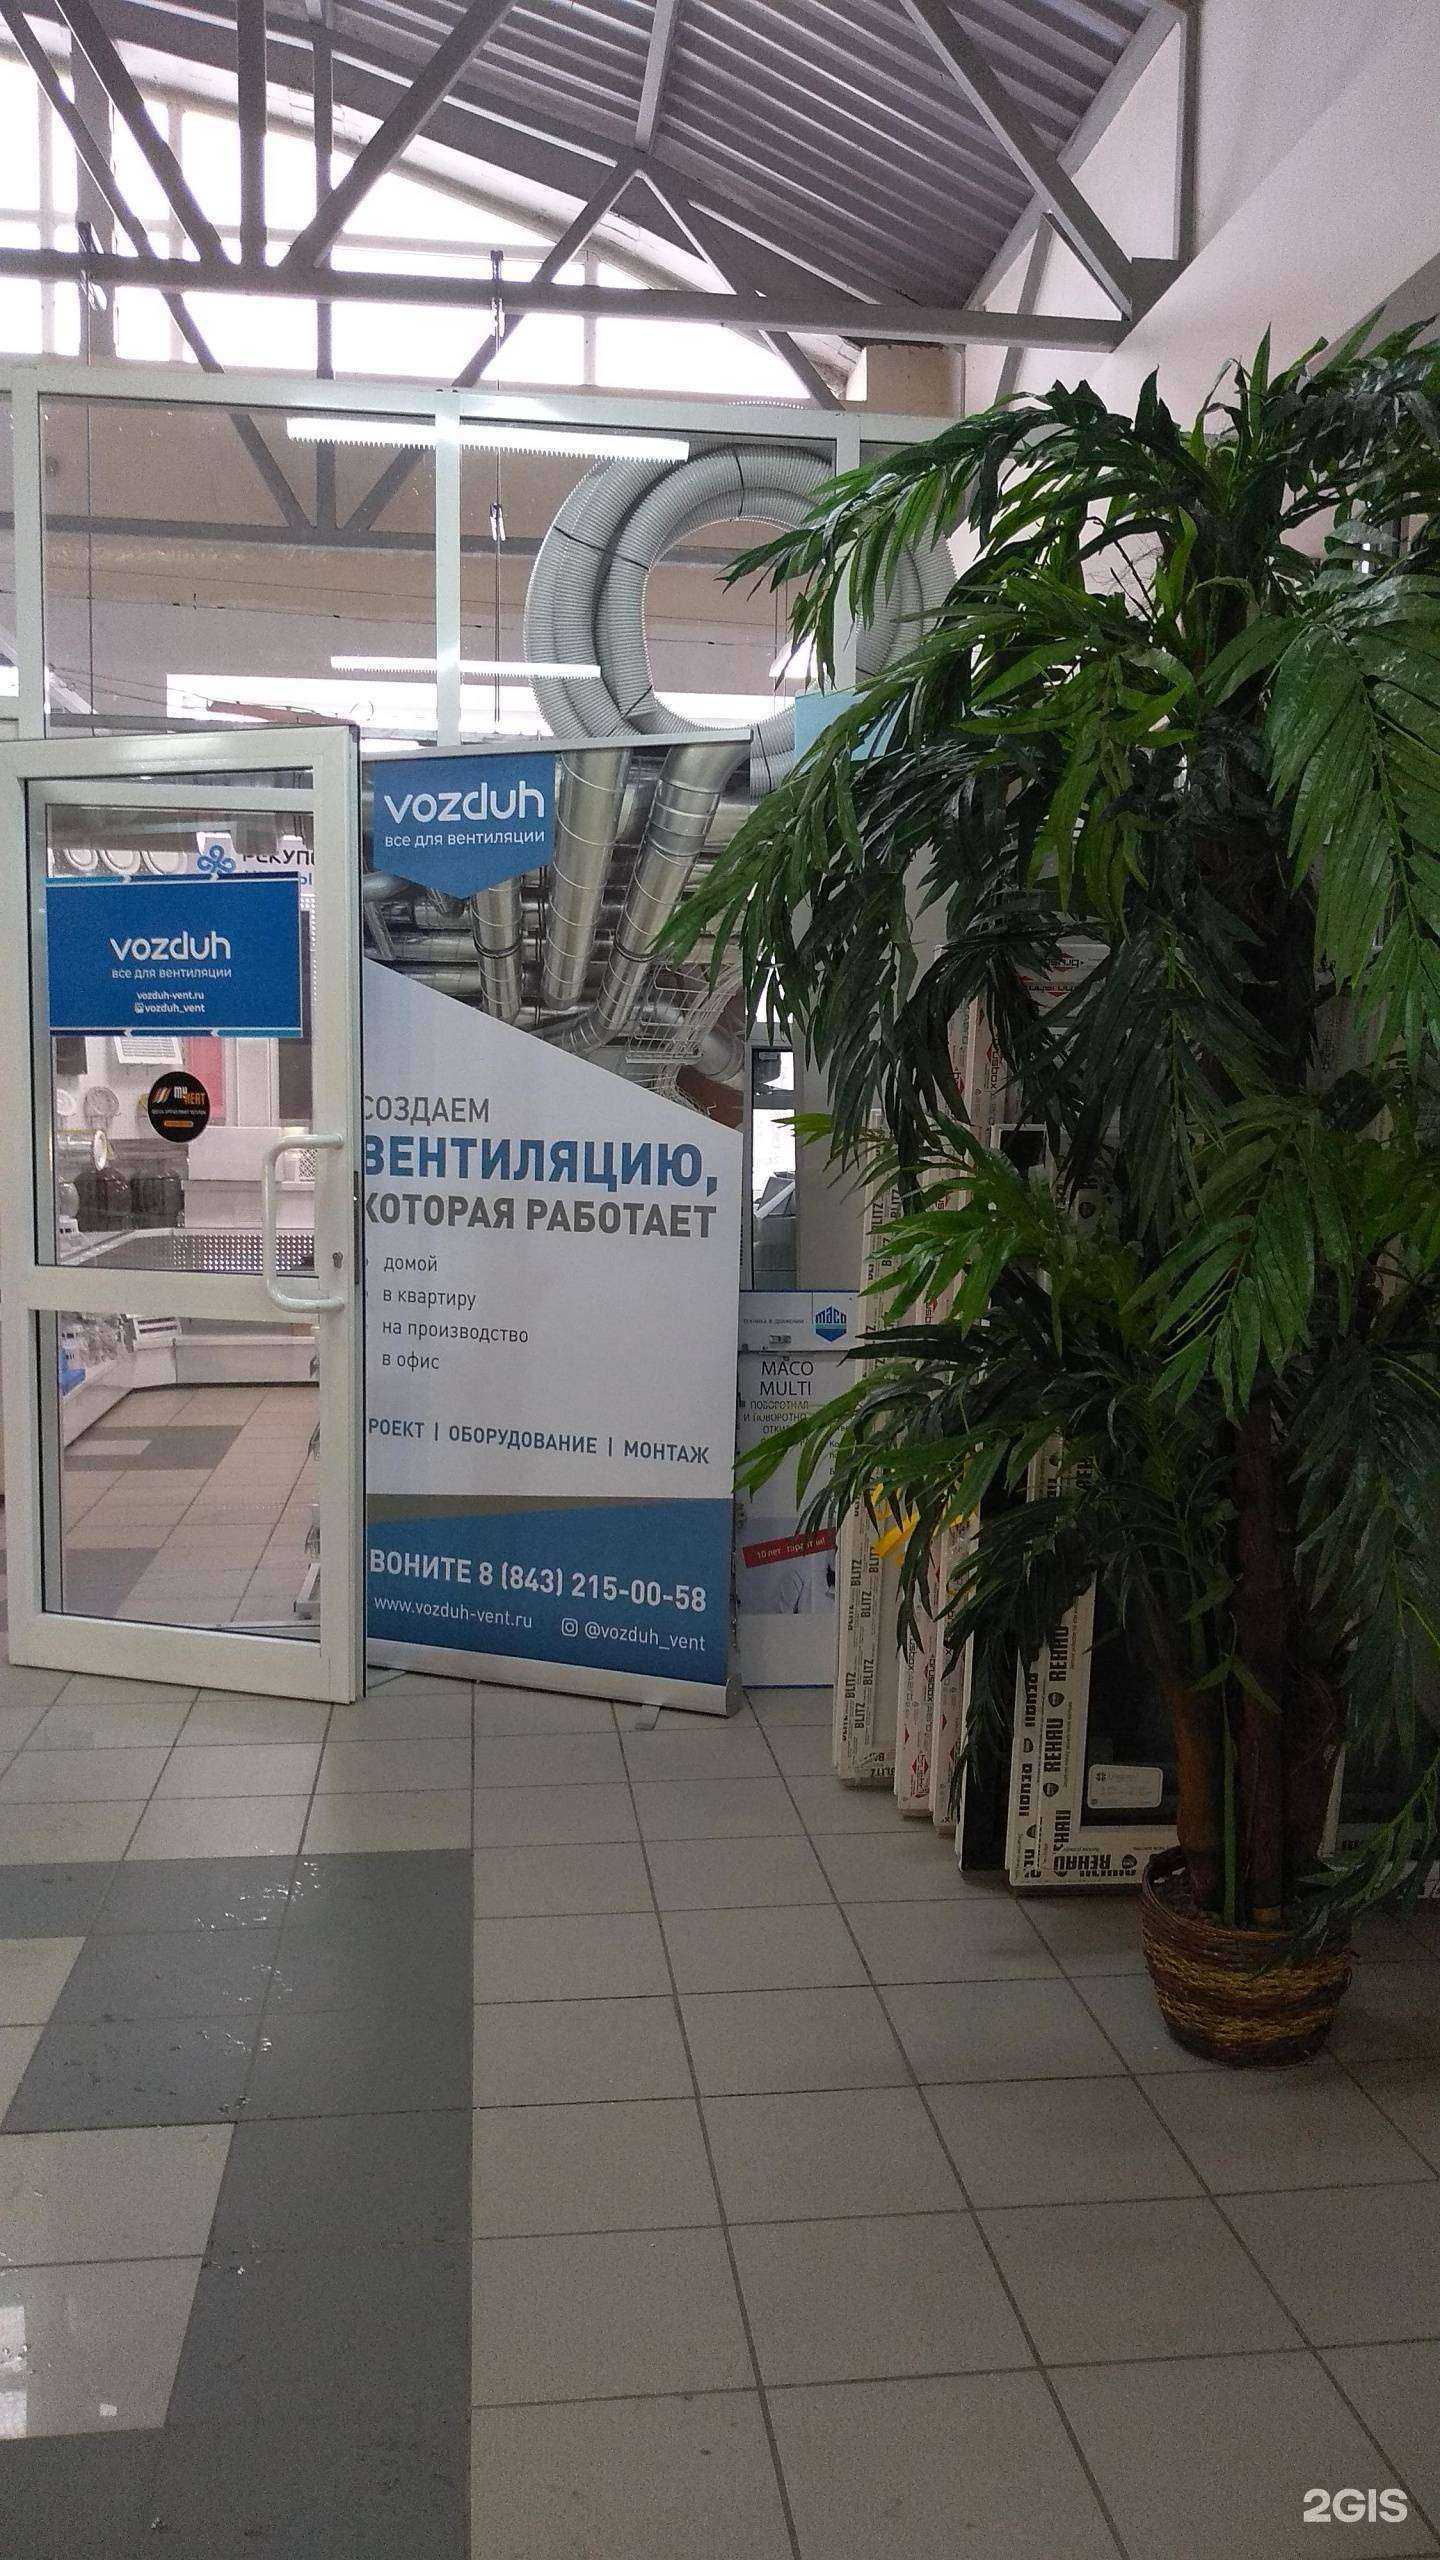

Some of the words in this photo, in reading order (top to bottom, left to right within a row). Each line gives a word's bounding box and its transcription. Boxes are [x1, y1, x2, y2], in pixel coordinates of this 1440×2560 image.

[384, 780, 544, 824] vozduh
[385, 834, 411, 847] все
[414, 833, 444, 849] для
[448, 829, 545, 847] вентиляции
[109, 931, 231, 962] vozduh
[112, 968, 131, 979] все
[134, 967, 156, 981] для
[159, 967, 232, 979] вентиляции
[136, 991, 204, 1001] vozduh-vent.ru
[364, 1095, 489, 1127] СОЗДАЕМ
[364, 1134, 717, 1197] ВЕНТИЛЯЦИЮ,
[365, 1192, 516, 1229] КОТОРАЯ
[527, 1199, 717, 1238] РАБОТАЕТ
[384, 1255, 438, 1274] домой
[383, 1289, 392, 1302] в
[398, 1289, 476, 1311] квартиру
[815, 1306, 847, 1325] maco
[382, 1321, 402, 1335] на
[407, 1322, 529, 1344] производство
[382, 1352, 391, 1366] в
[397, 1353, 440, 1372] офис
[761, 1360, 814, 1376] MACO
[760, 1381, 812, 1396] MULTI
[449, 1424, 598, 1454] ОБОРУДОВАНИЕ
[624, 1440, 709, 1464] МОНТАЖ
[850, 1559, 862, 1586] BLITZ
[479, 1562, 492, 1586] 8
[501, 1562, 564, 1598] (843)
[571, 1571, 707, 1612] 215-00-58
[861, 1591, 872, 1618] BLITZ
[374, 1598, 532, 1630] www.vozduh-vent.ru
[585, 1621, 706, 1651] @vozduh_vent
[845, 1672, 857, 1699] BLITZ
[863, 1658, 875, 1686] BLITZ
[855, 1702, 866, 1729] BLITZ
[1043, 1717, 1064, 1773] REHAU
[1054, 1854, 1111, 1871] REHAU
